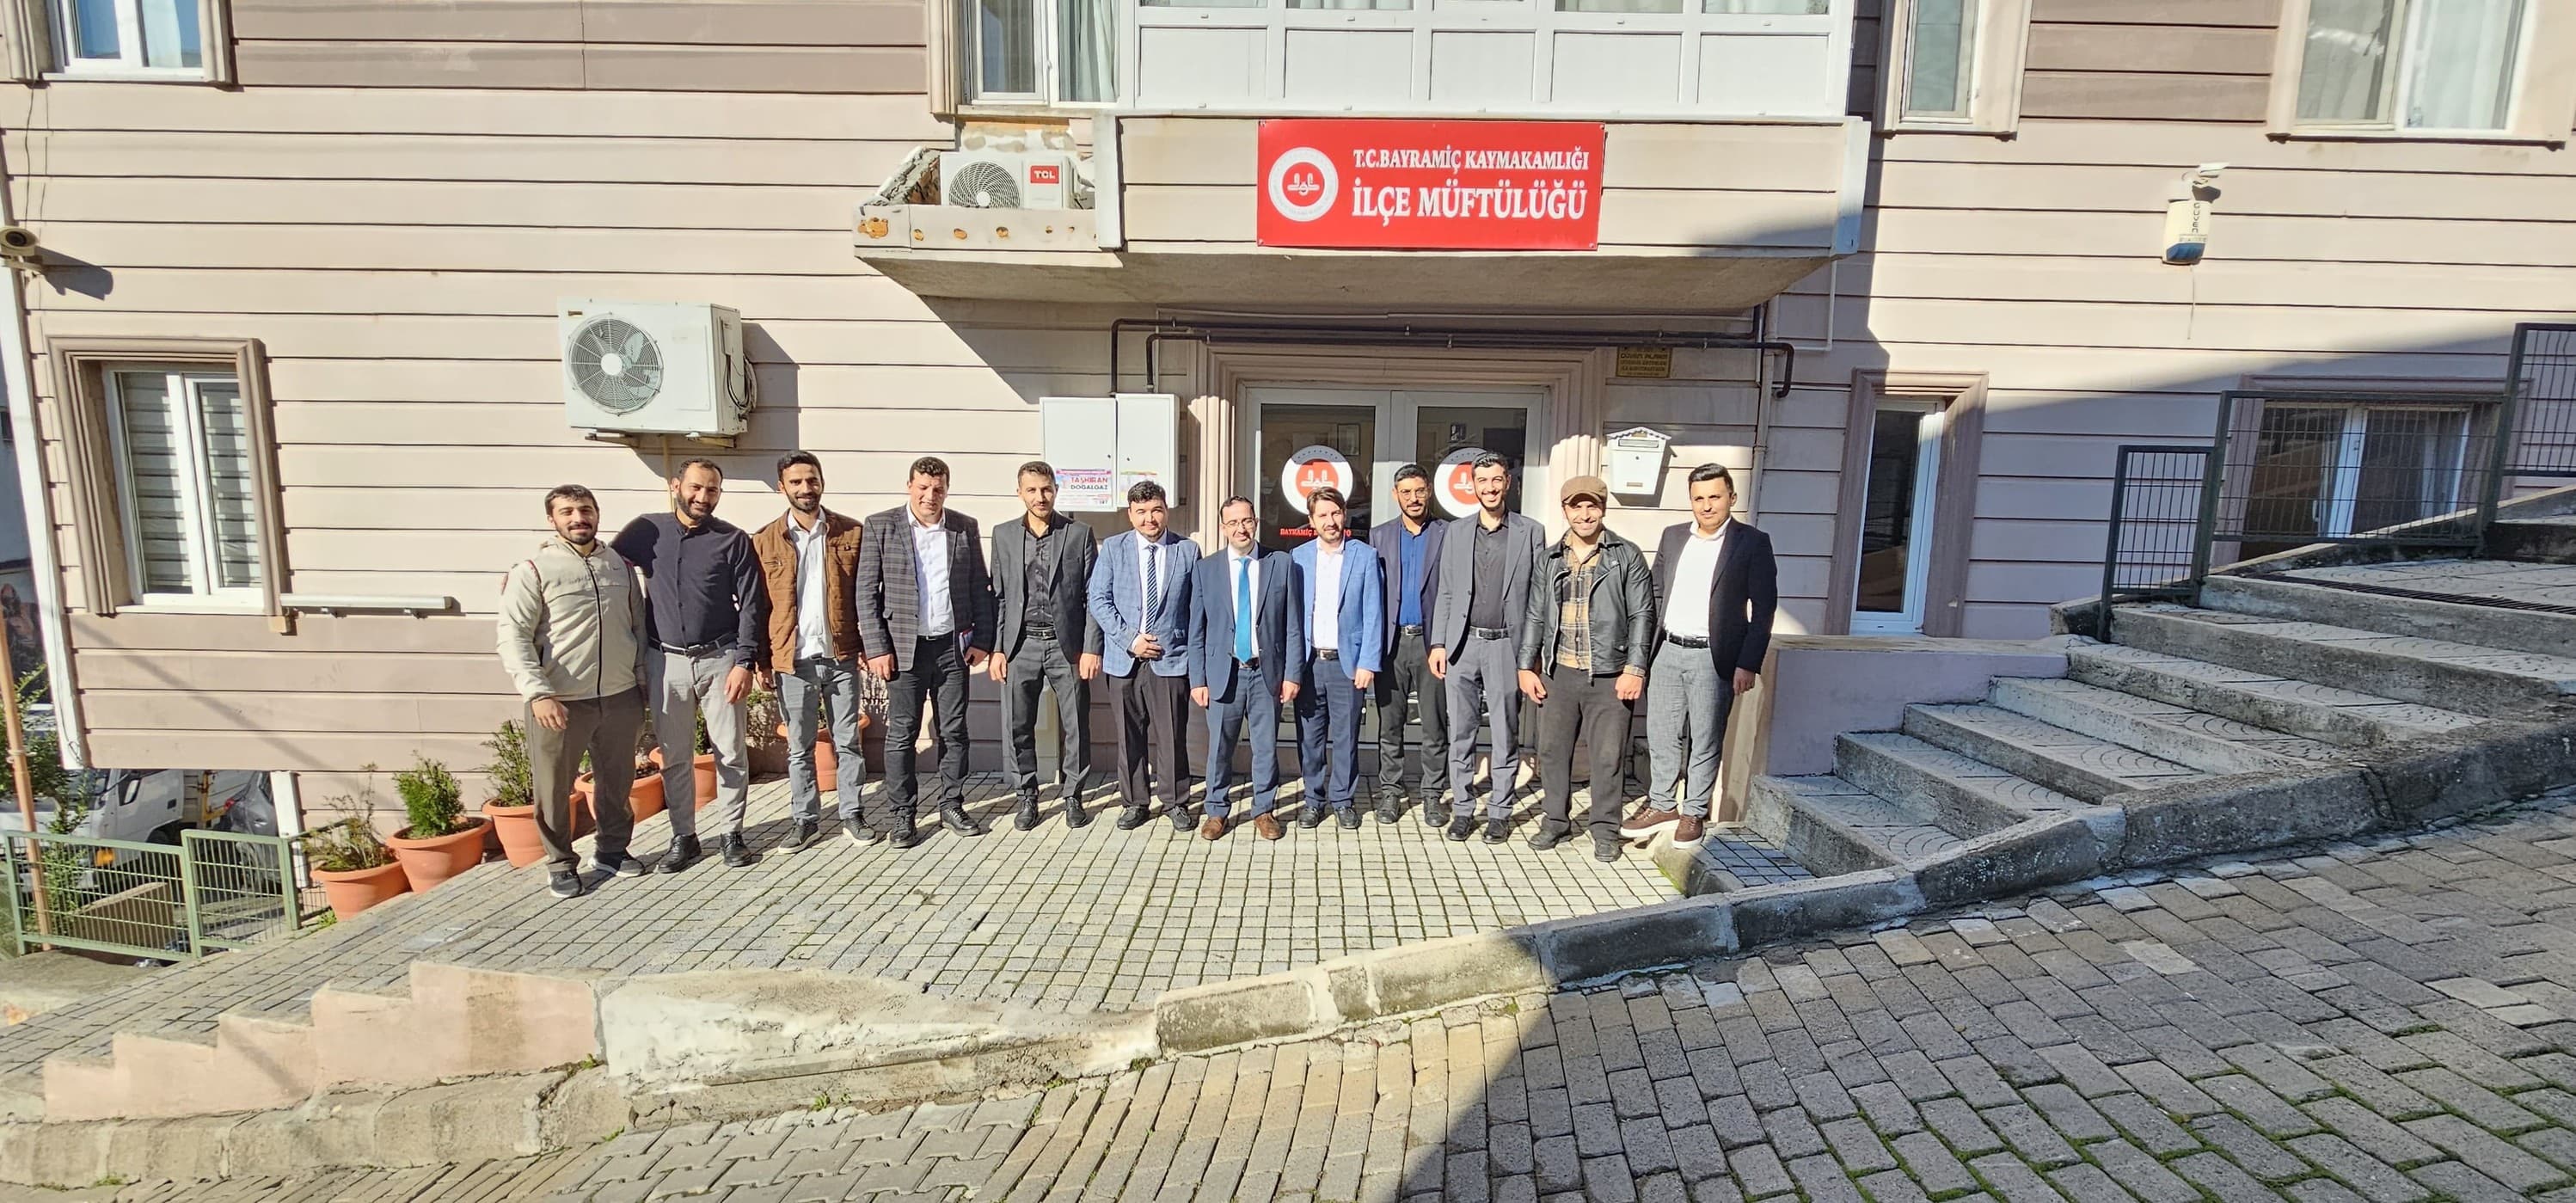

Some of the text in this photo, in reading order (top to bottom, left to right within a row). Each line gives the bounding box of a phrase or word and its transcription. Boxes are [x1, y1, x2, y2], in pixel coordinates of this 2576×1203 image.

[1033, 170, 1056, 180] TCL
[1352, 144, 1590, 175] T.C.BAYRAMİÇ KAYMAKAMLIĞI
[1352, 177, 1588, 227] İLÇE MÜFTÜLÜĞÜ
